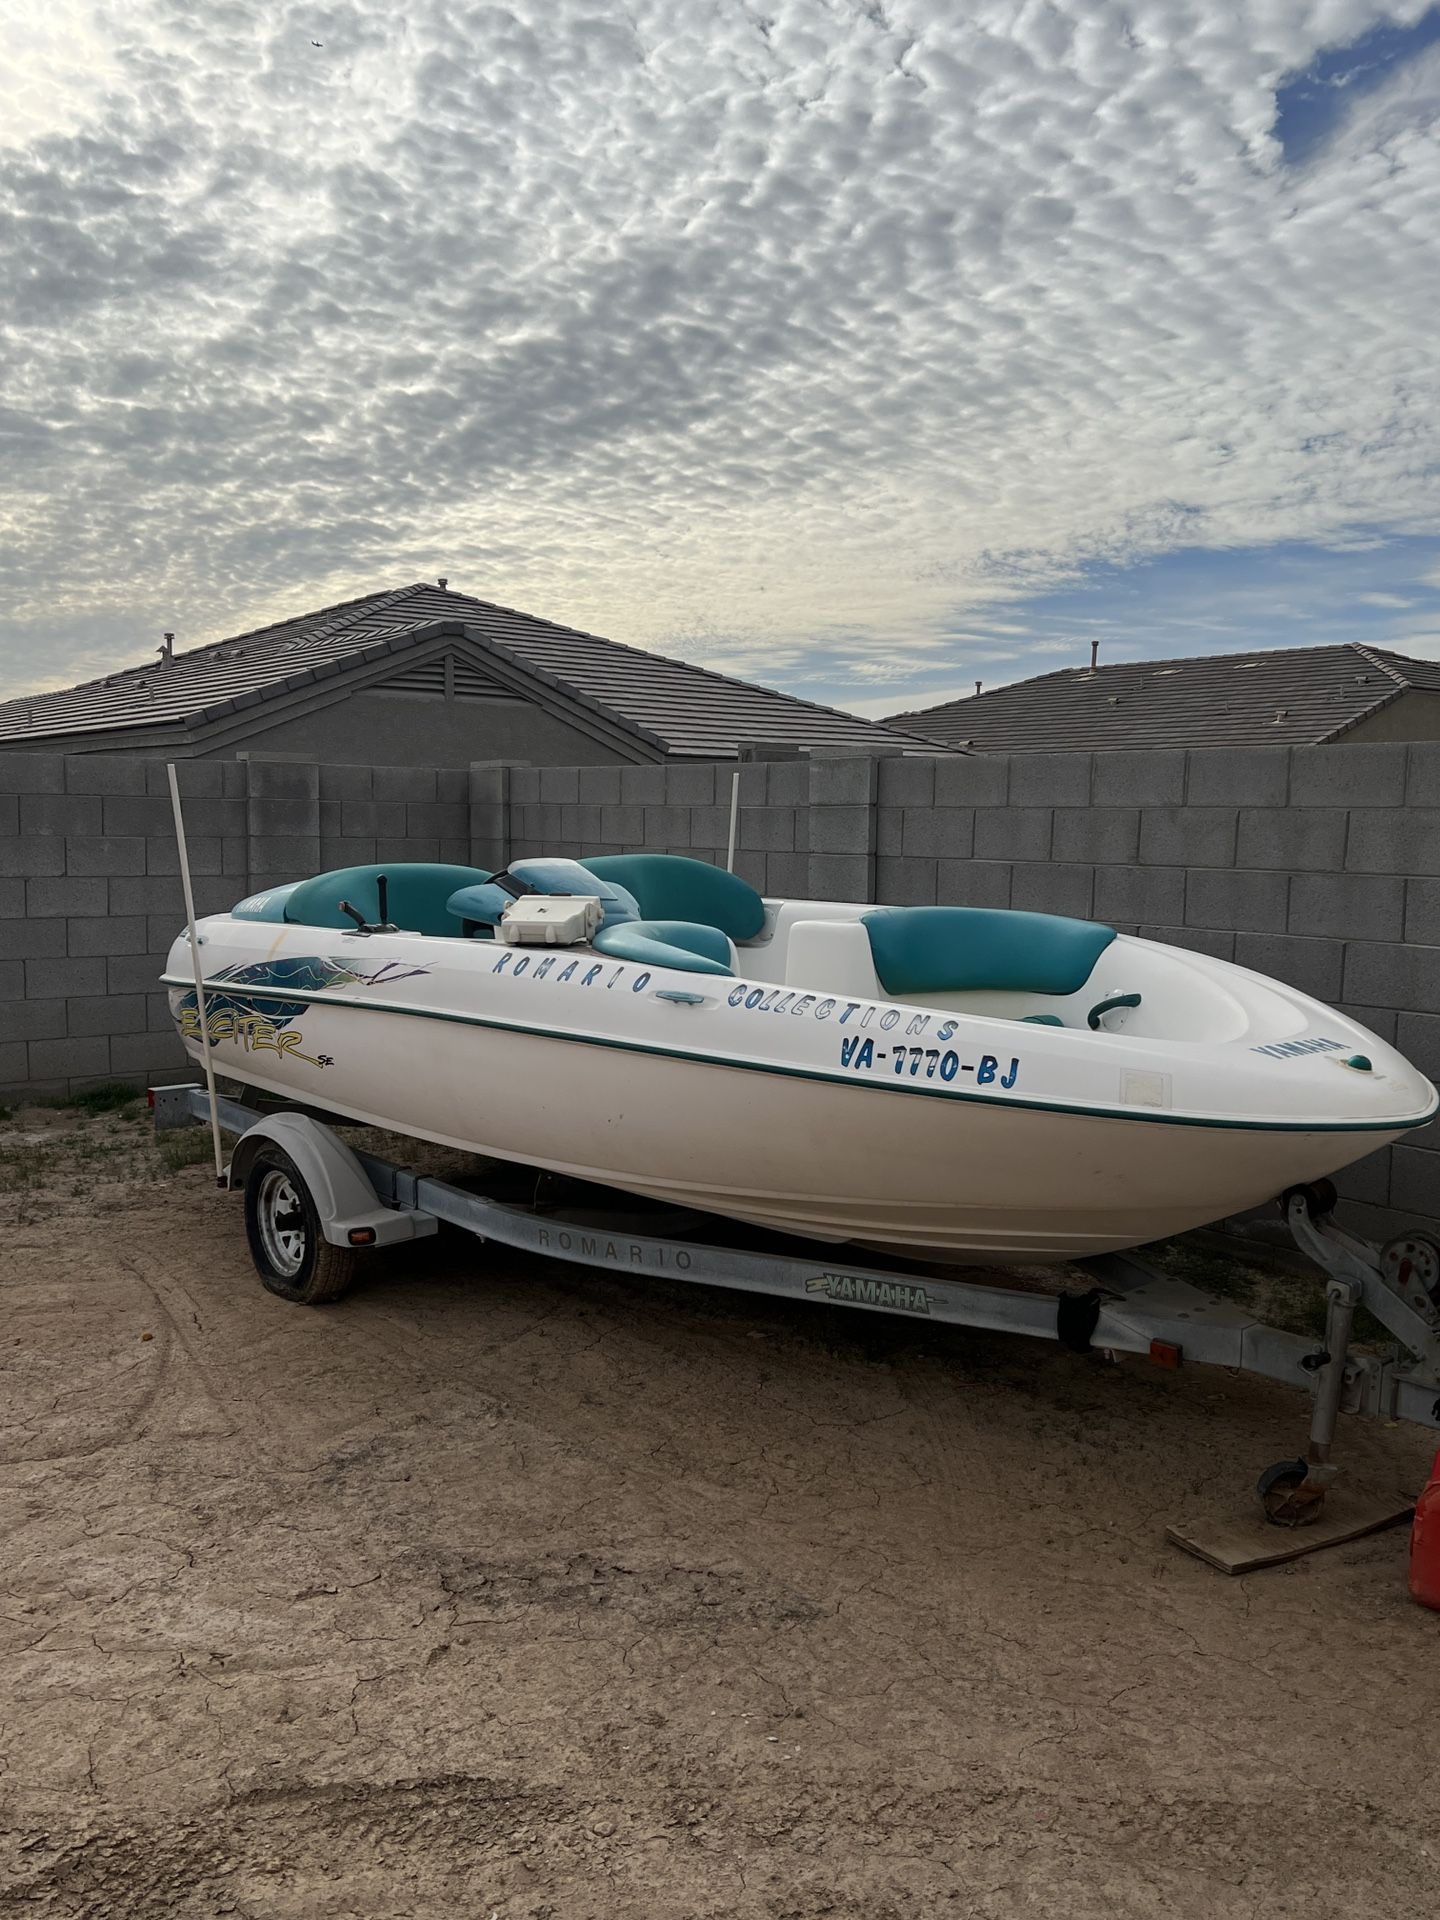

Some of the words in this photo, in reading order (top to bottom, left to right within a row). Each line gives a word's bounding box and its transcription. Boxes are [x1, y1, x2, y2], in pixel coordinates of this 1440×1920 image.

[492, 952, 651, 993] ROMARIO
[728, 984, 959, 1040] COLLECTIONS
[317, 1055, 335, 1066] SE
[1250, 1038, 1352, 1060] YAMAHA
[538, 1228, 691, 1271] ROMARIO
[823, 1273, 930, 1315] YAMAHA
